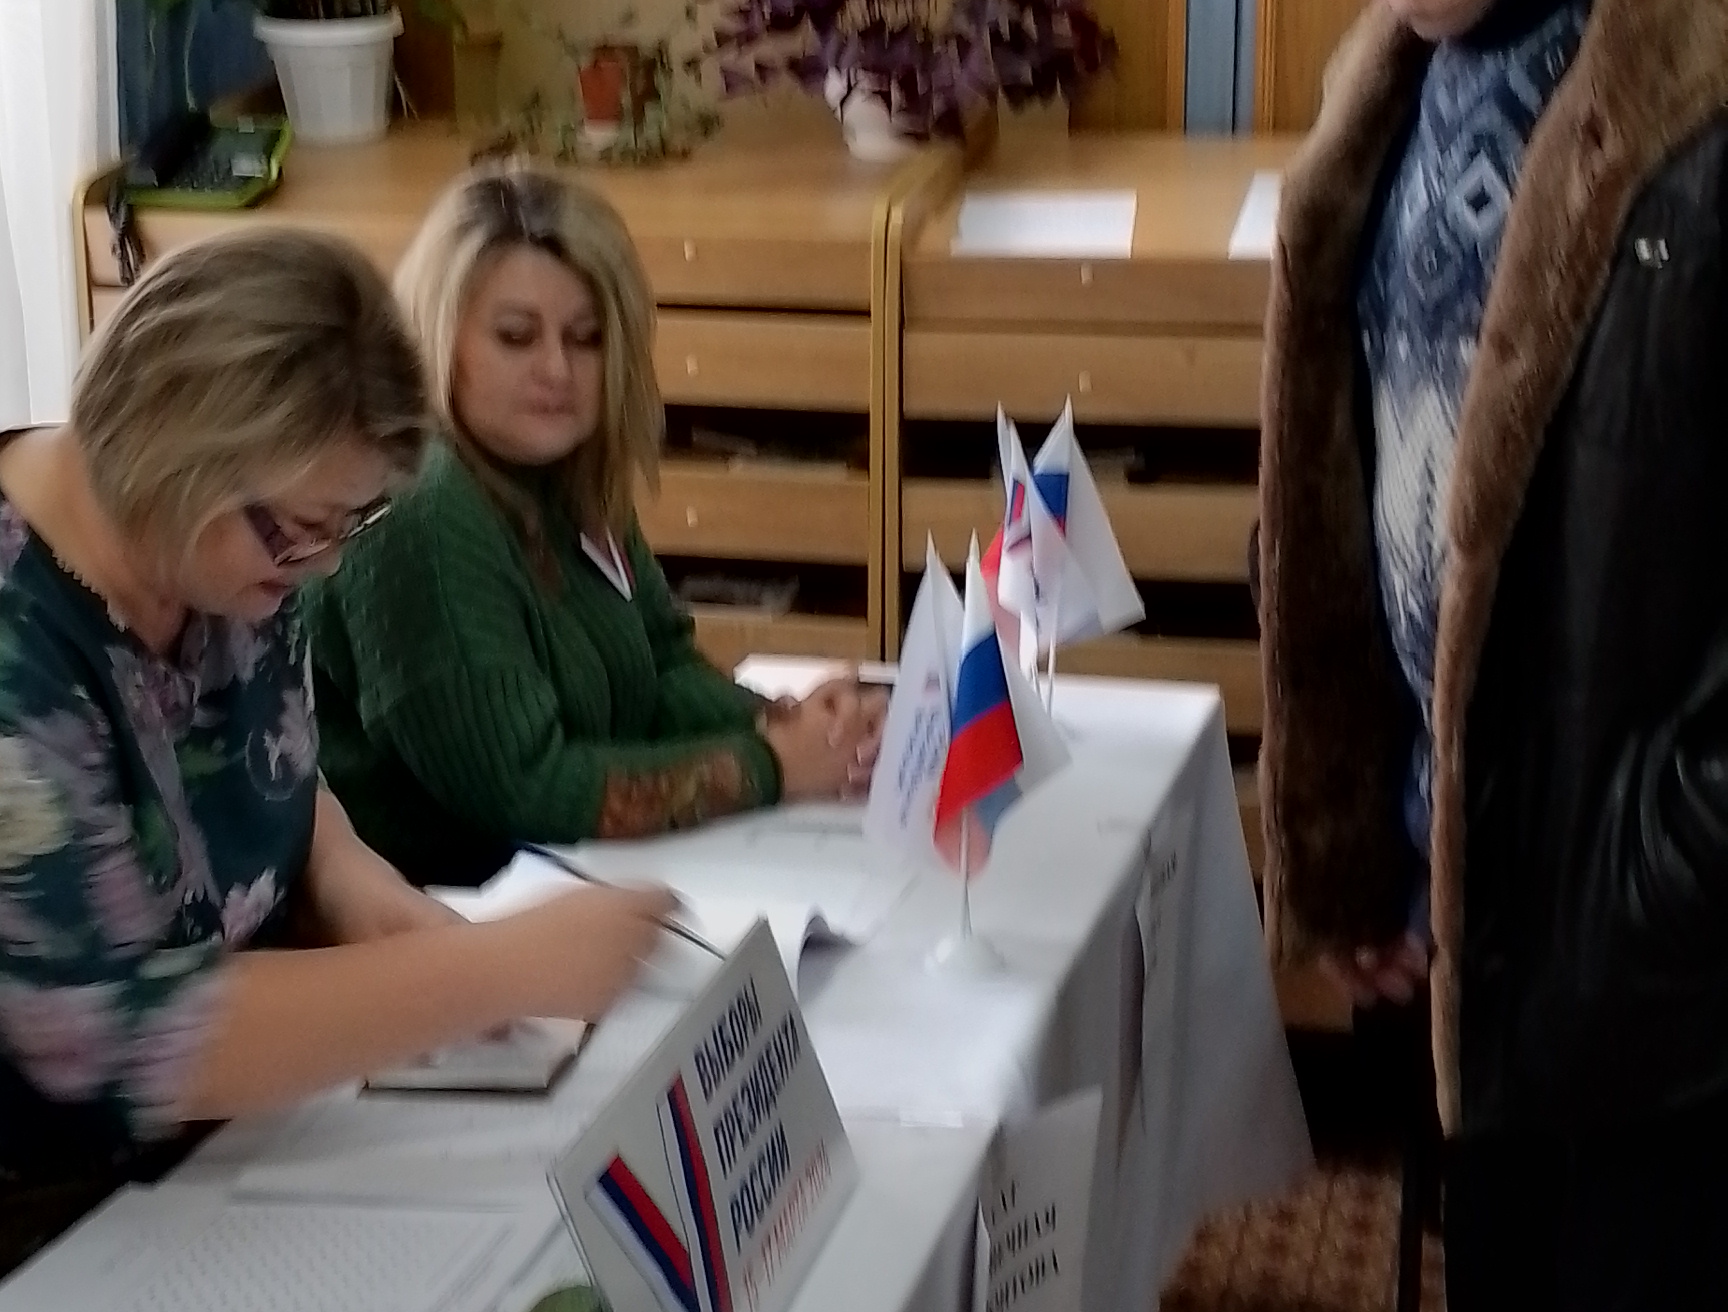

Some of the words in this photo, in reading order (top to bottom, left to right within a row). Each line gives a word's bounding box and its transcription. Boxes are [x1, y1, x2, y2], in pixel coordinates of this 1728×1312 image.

[694, 975, 763, 1102] ВЫБОРЫ
[712, 1008, 802, 1179] ПРЕЗИДЕНТА
[729, 1117, 791, 1256] РОССИИ
